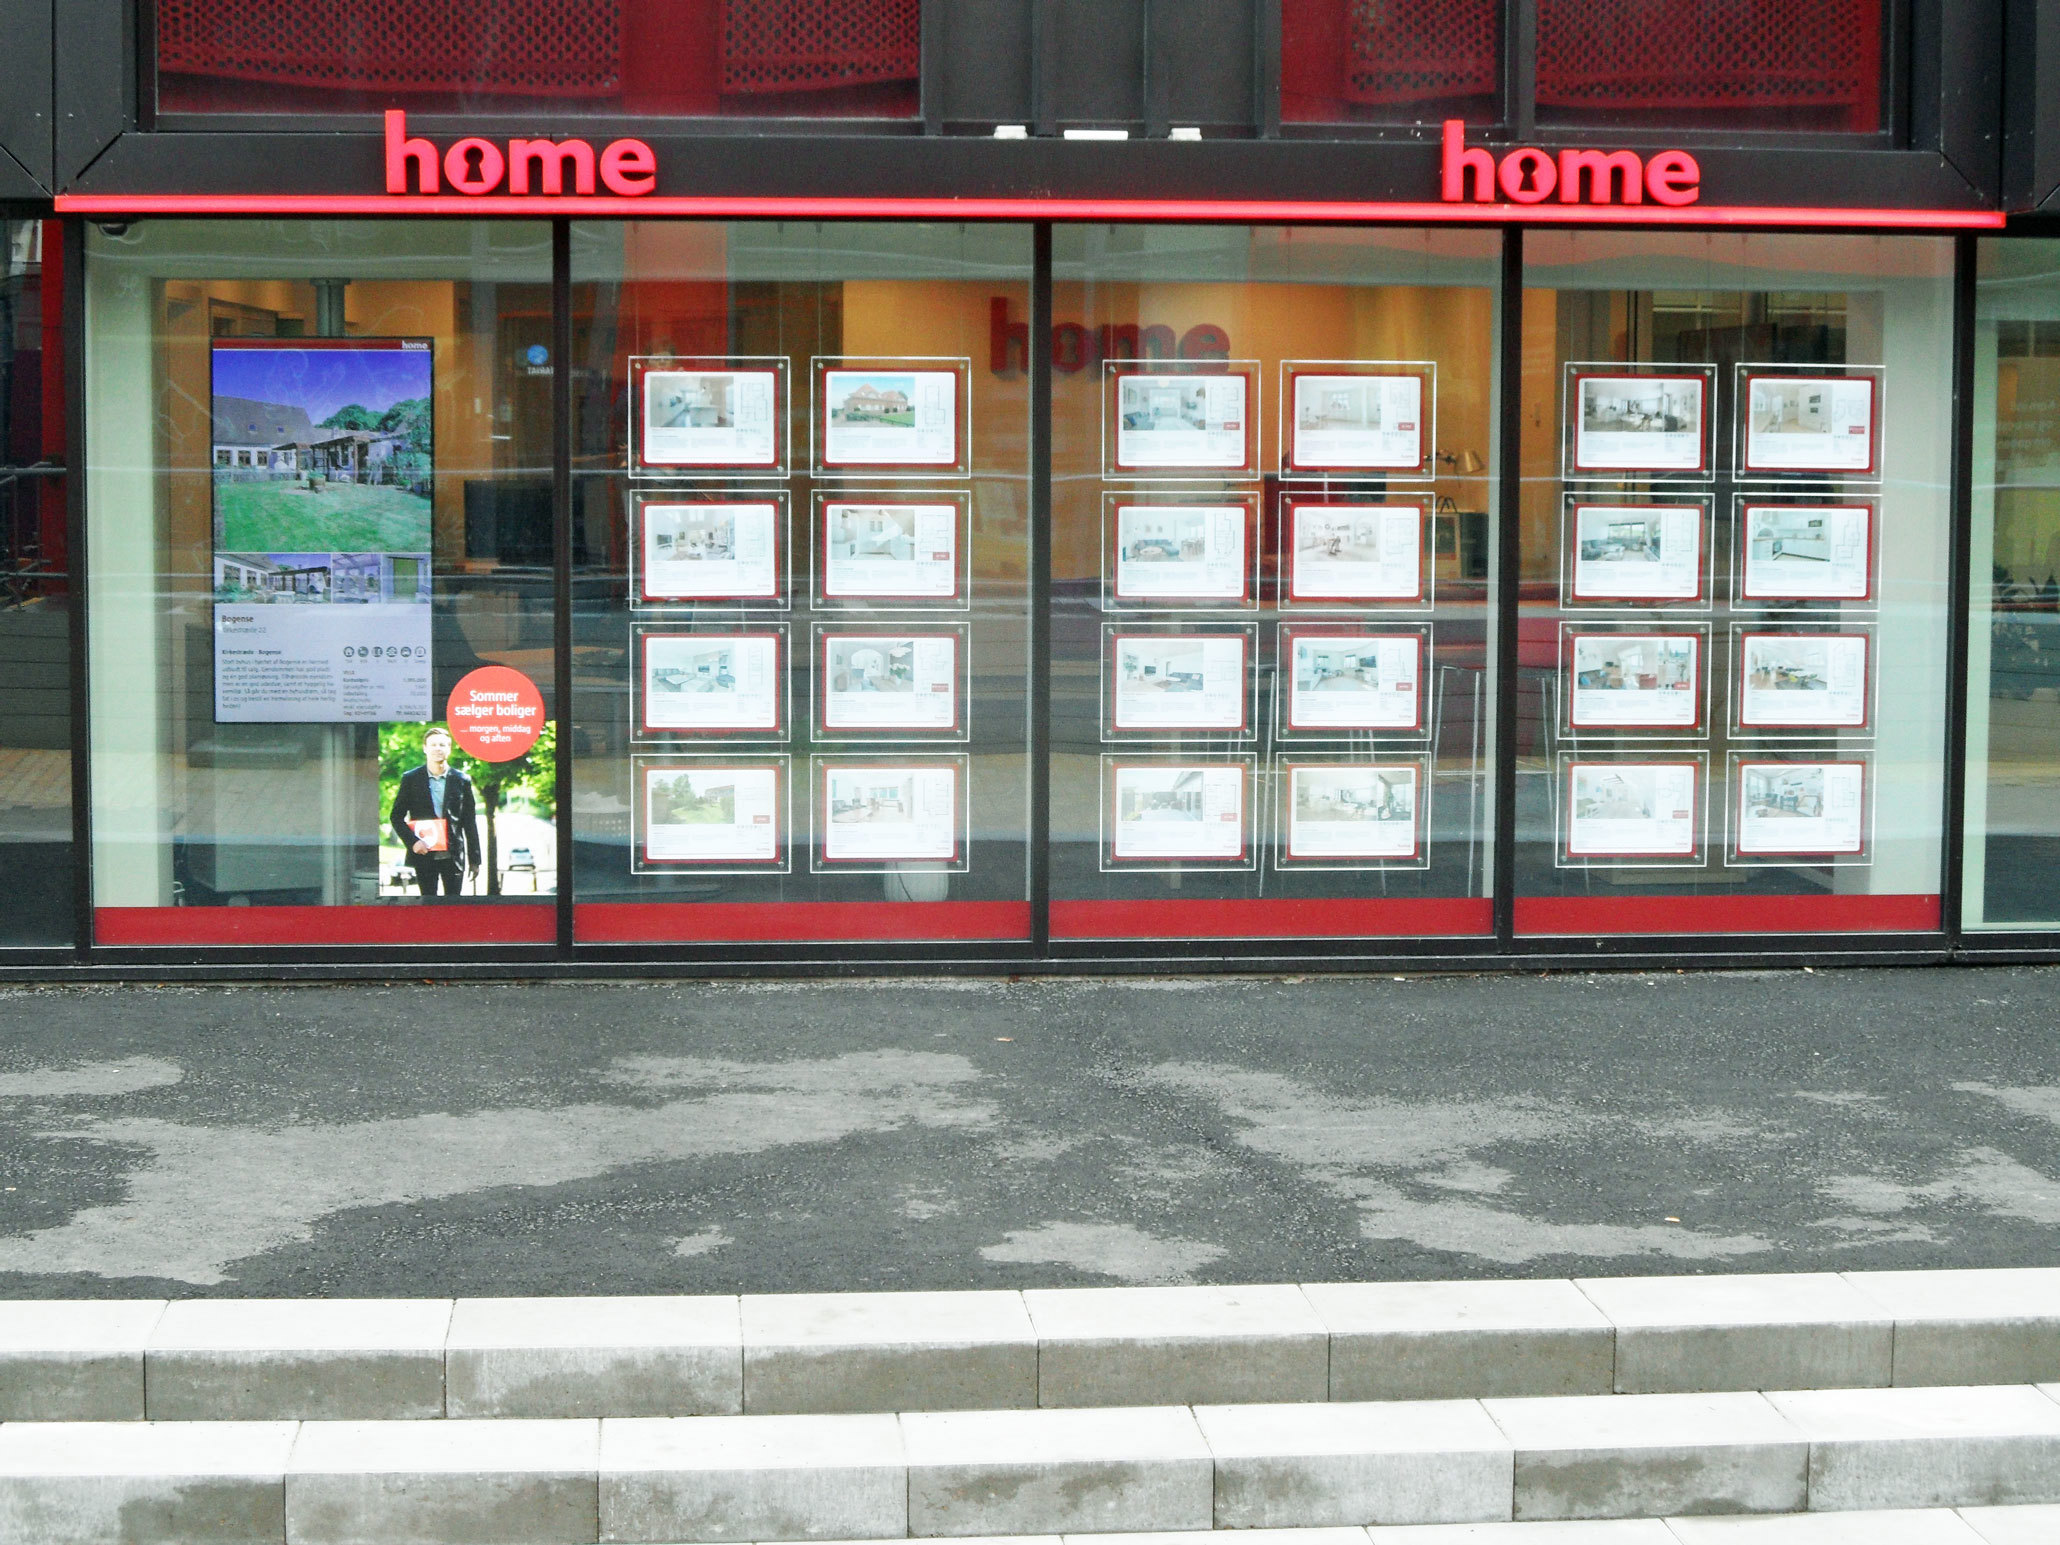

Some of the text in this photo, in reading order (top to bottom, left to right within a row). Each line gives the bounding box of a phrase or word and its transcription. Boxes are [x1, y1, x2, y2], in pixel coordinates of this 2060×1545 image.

[385, 109, 657, 196] home
[1442, 119, 1700, 206] home
[990, 296, 1231, 373] home
[401, 339, 427, 349] home
[221, 615, 254, 624] Bogense
[469, 690, 519, 702] Sommer
[454, 703, 536, 718] sælger boliger
[469, 725, 501, 734] morgen,
[502, 724, 531, 734] middag
[479, 734, 511, 743] og aften
